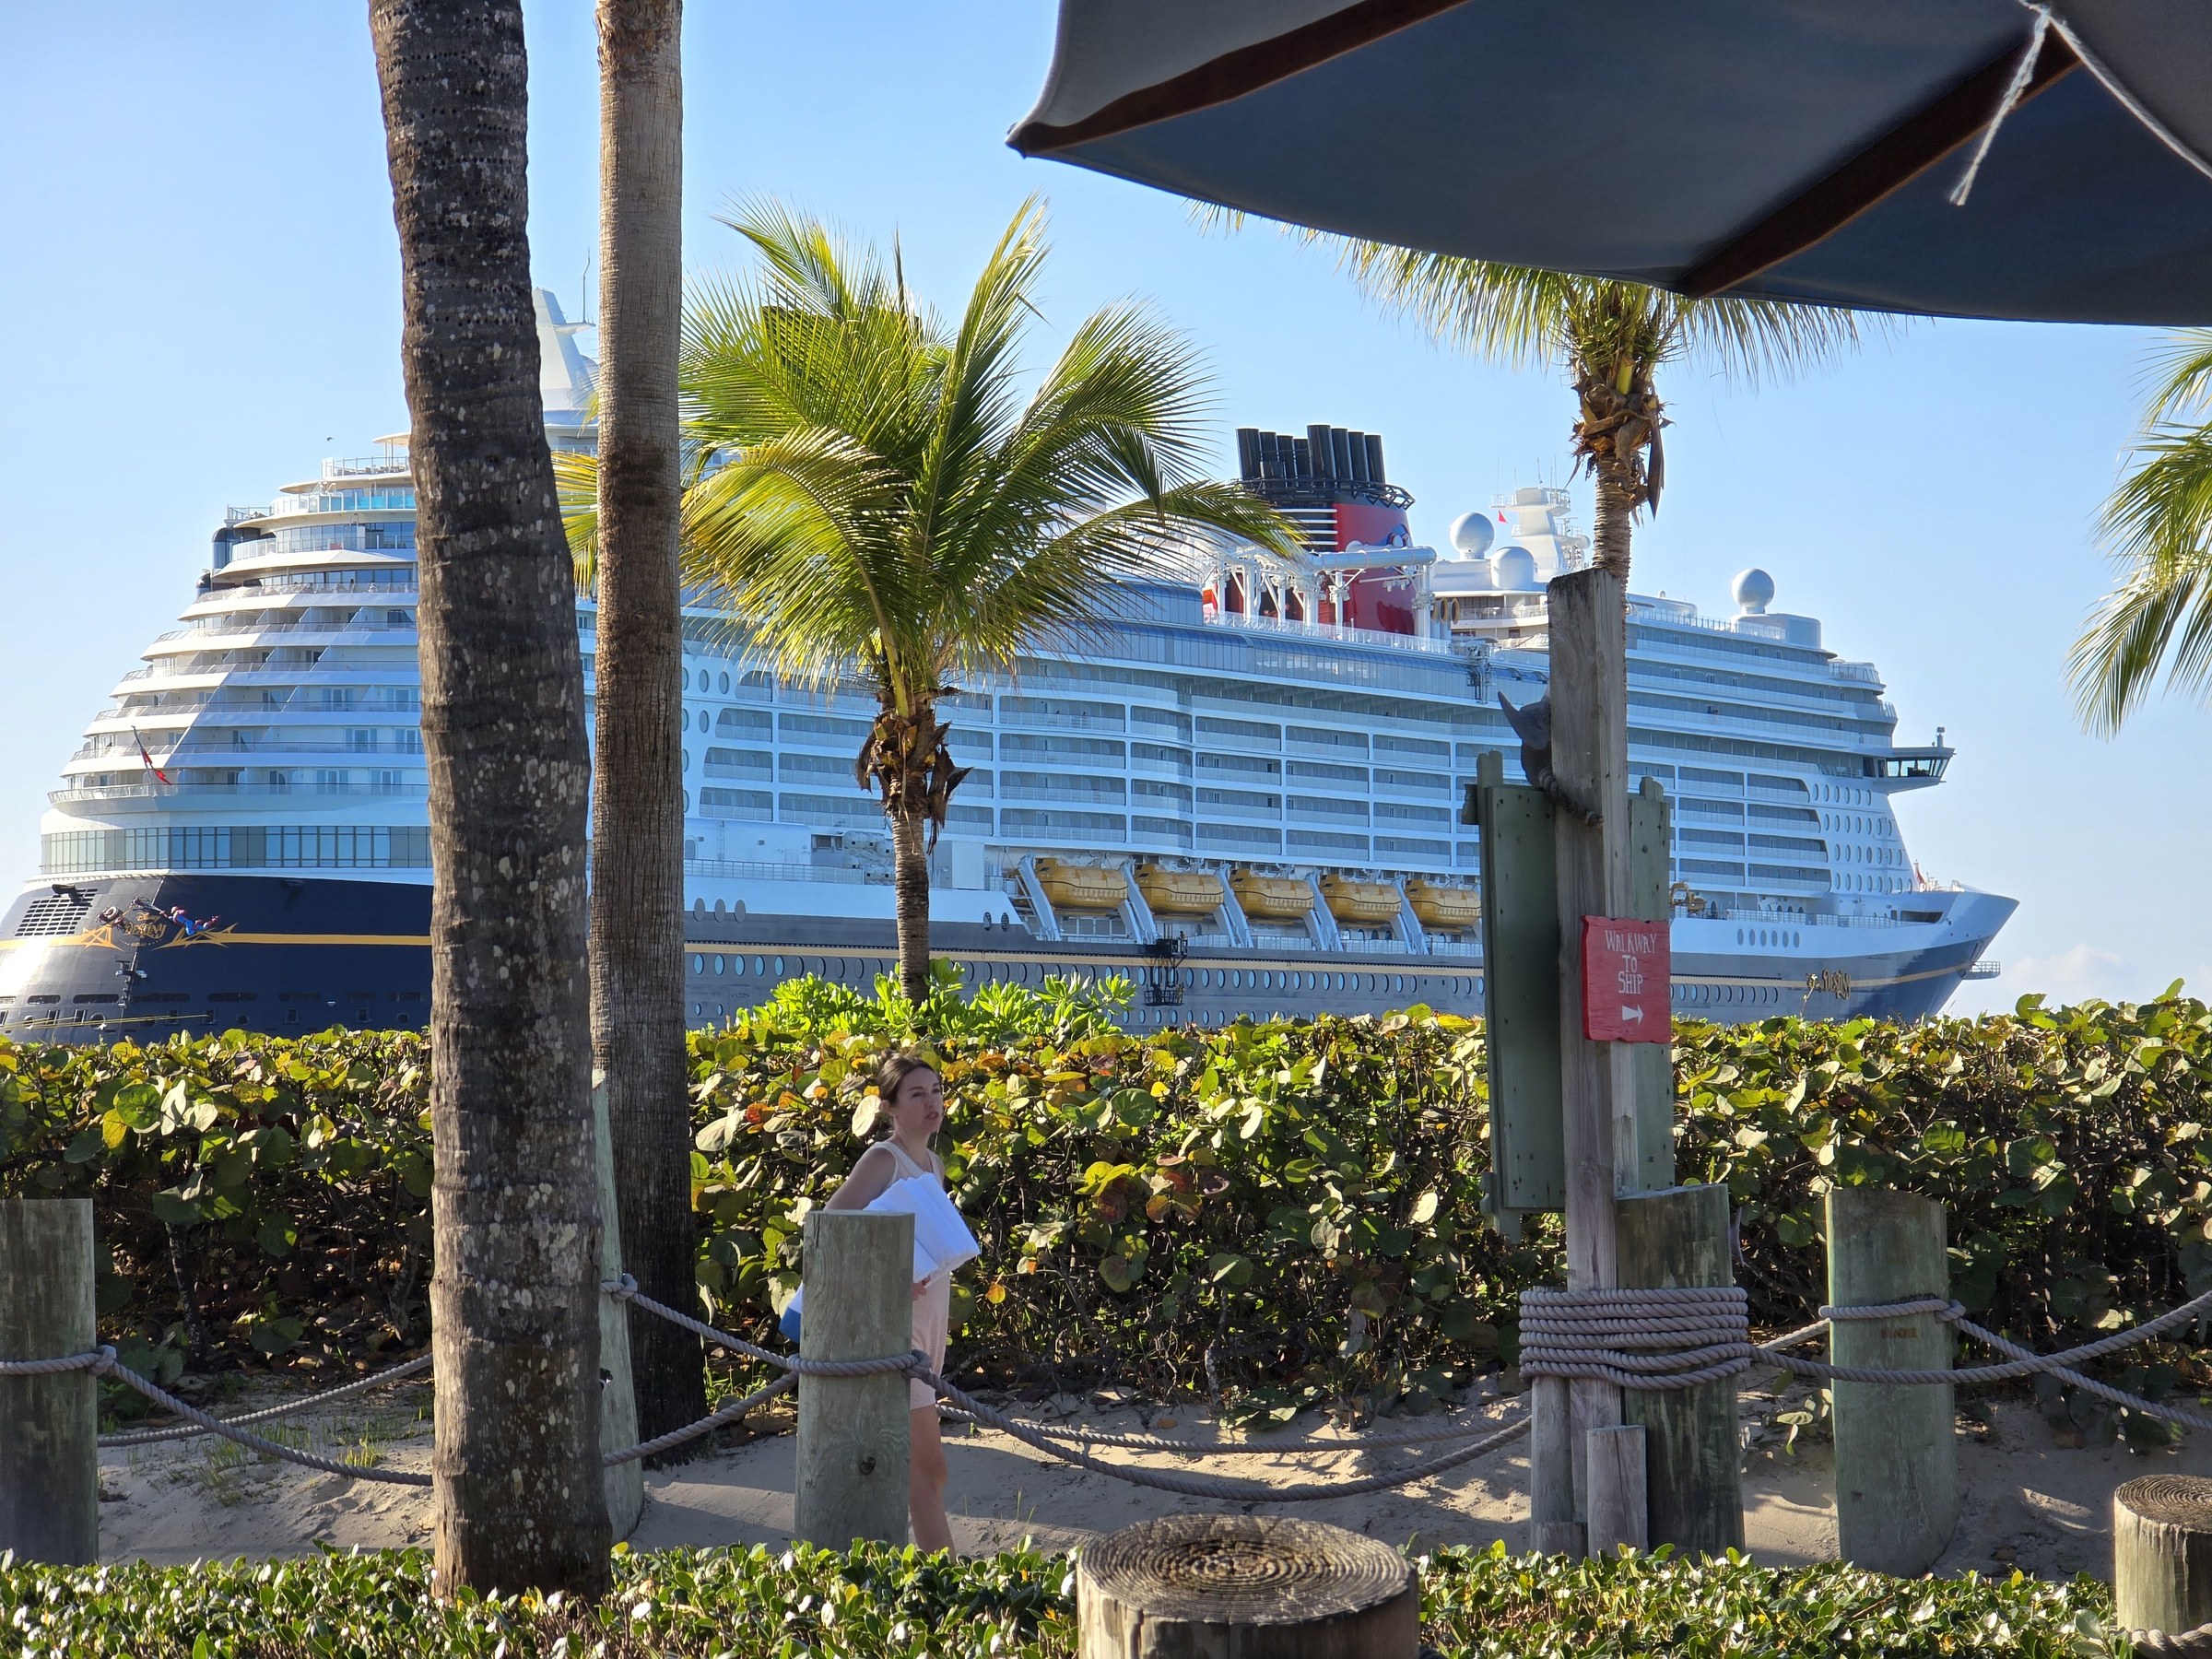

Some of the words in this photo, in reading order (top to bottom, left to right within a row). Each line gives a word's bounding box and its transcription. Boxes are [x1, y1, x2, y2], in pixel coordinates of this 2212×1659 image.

[1605, 929, 1657, 954] WALKWAY
[1622, 954, 1638, 973] TO
[1618, 971, 1643, 994] SHIP
